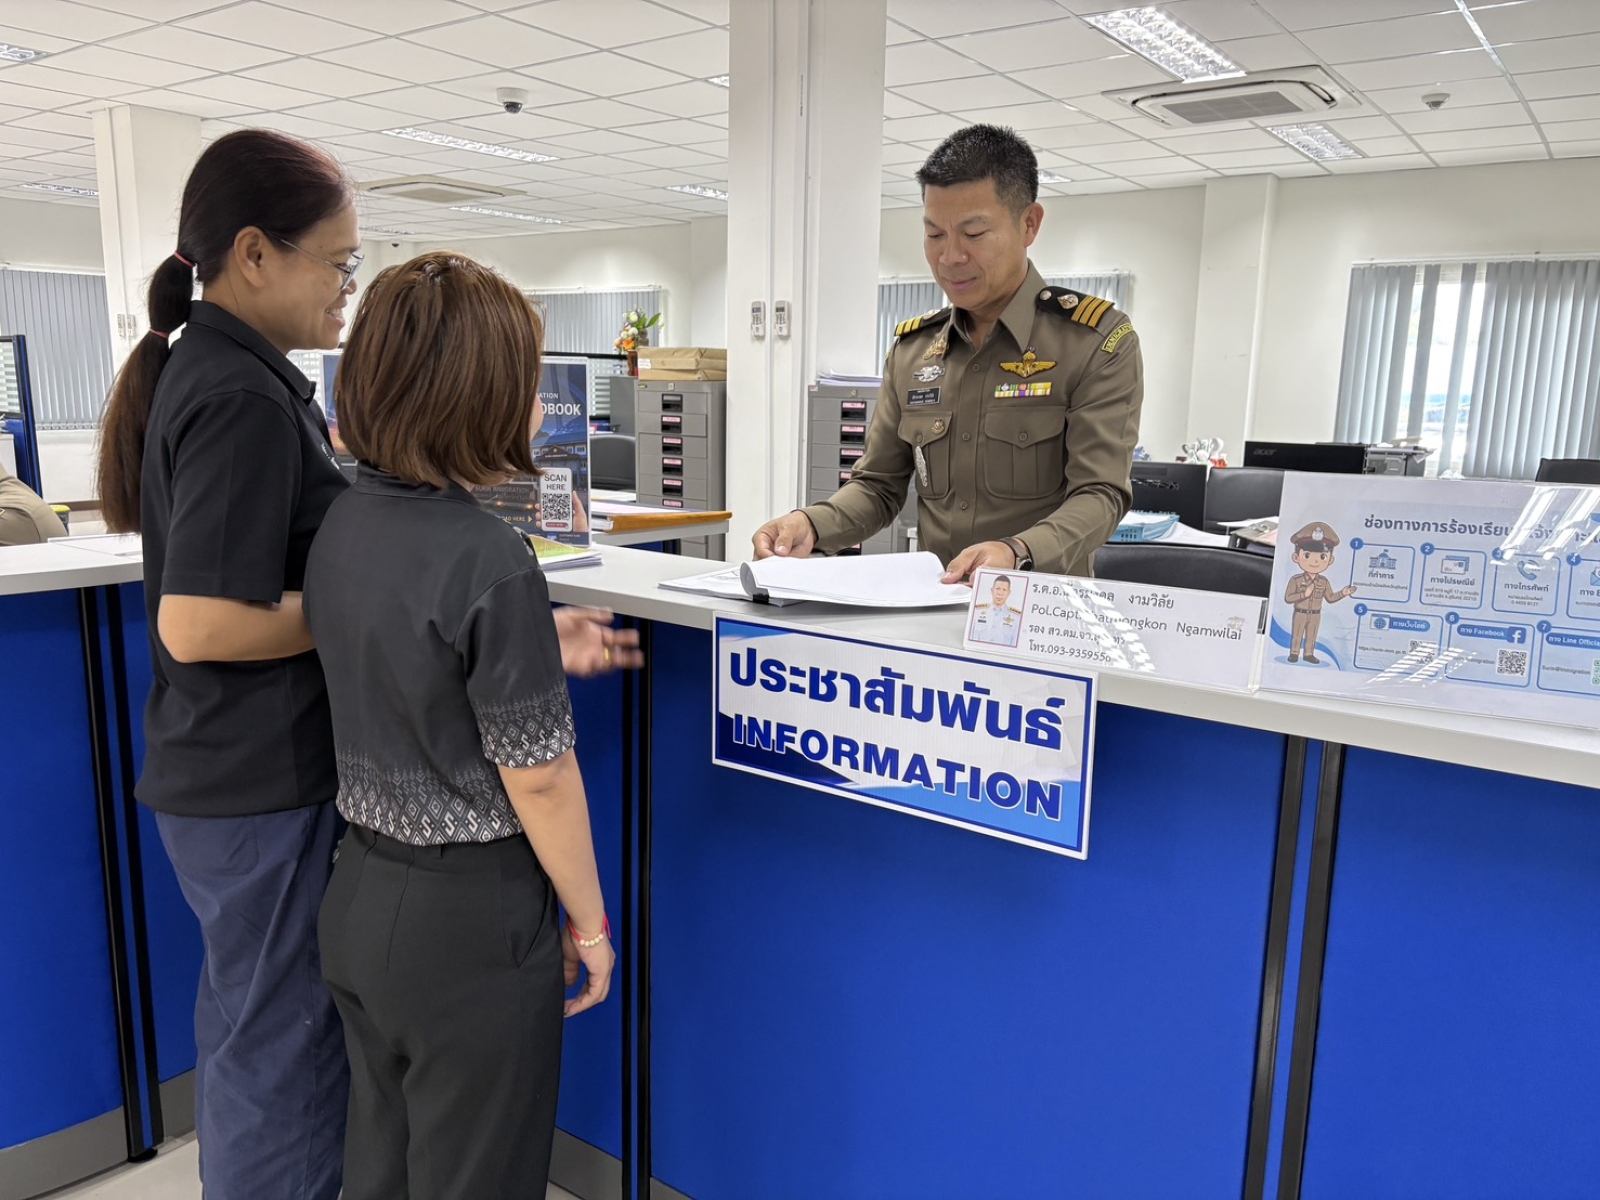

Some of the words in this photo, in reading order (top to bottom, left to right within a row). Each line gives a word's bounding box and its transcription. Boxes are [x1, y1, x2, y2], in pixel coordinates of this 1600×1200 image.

[1252, 448, 1277, 456] acer
[544, 474, 567, 482] SCAN
[1368, 569, 1394, 579] ที่ทำการ
[1430, 575, 1475, 586] ทางไปรษณีย์
[1504, 582, 1549, 592] ทางโทรศัพท์
[1128, 592, 1174, 609] งามวิลัย
[1029, 624, 1045, 634] รอง
[1392, 621, 1426, 629] ทางเว็บไซต์
[1176, 621, 1242, 640] Ngamwilai
[1473, 627, 1505, 637] Facebook
[729, 647, 1066, 751] ประชาสัมพันธ์
[732, 713, 1064, 822] INFORMATION
